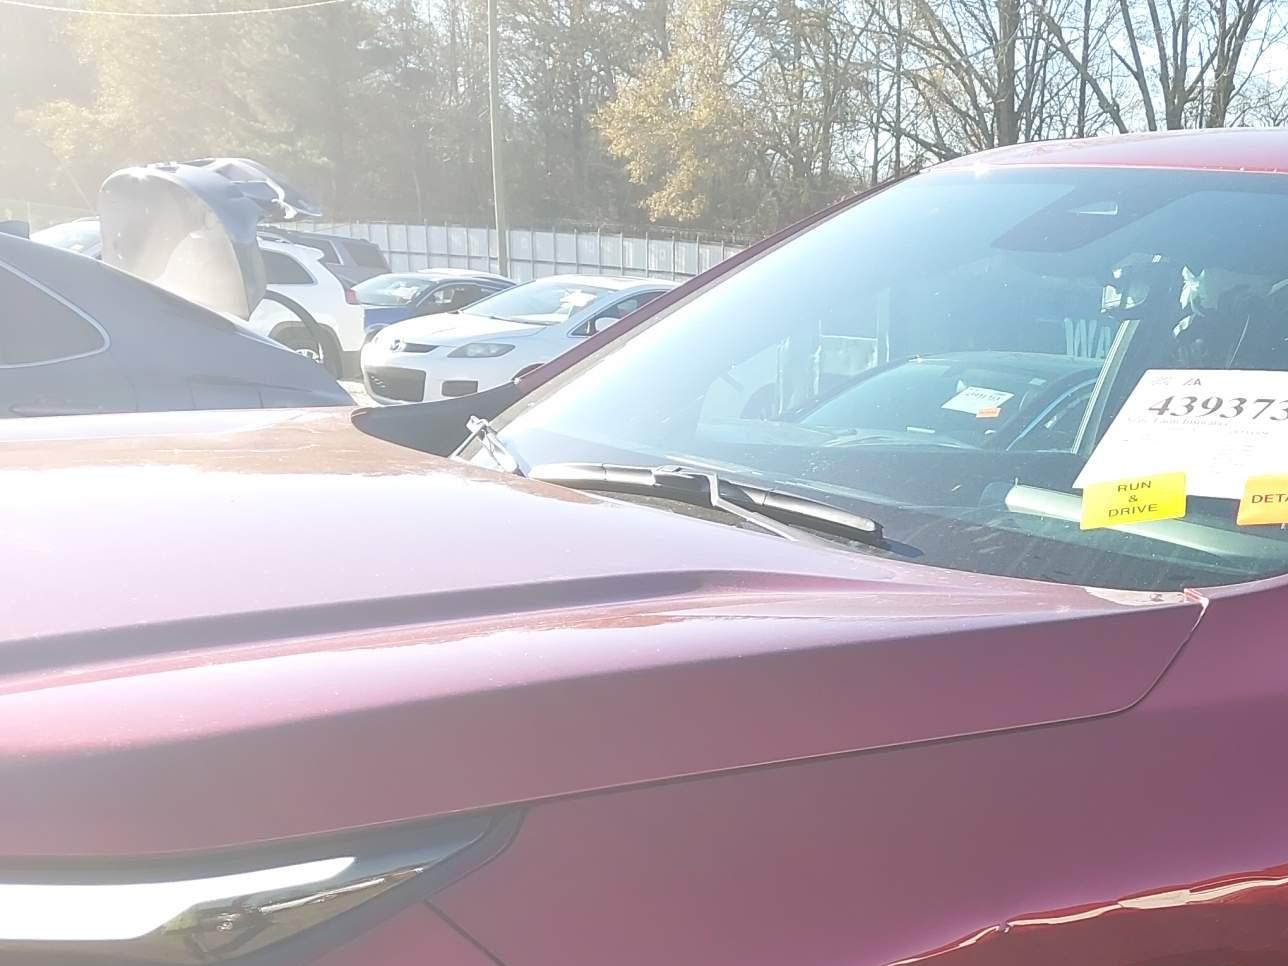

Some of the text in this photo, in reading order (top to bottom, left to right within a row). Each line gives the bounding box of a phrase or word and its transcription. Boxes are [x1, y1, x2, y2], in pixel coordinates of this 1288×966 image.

[1117, 480, 1152, 492] RUN
[1128, 494, 1139, 504] &
[1108, 503, 1159, 518] DRIVE
